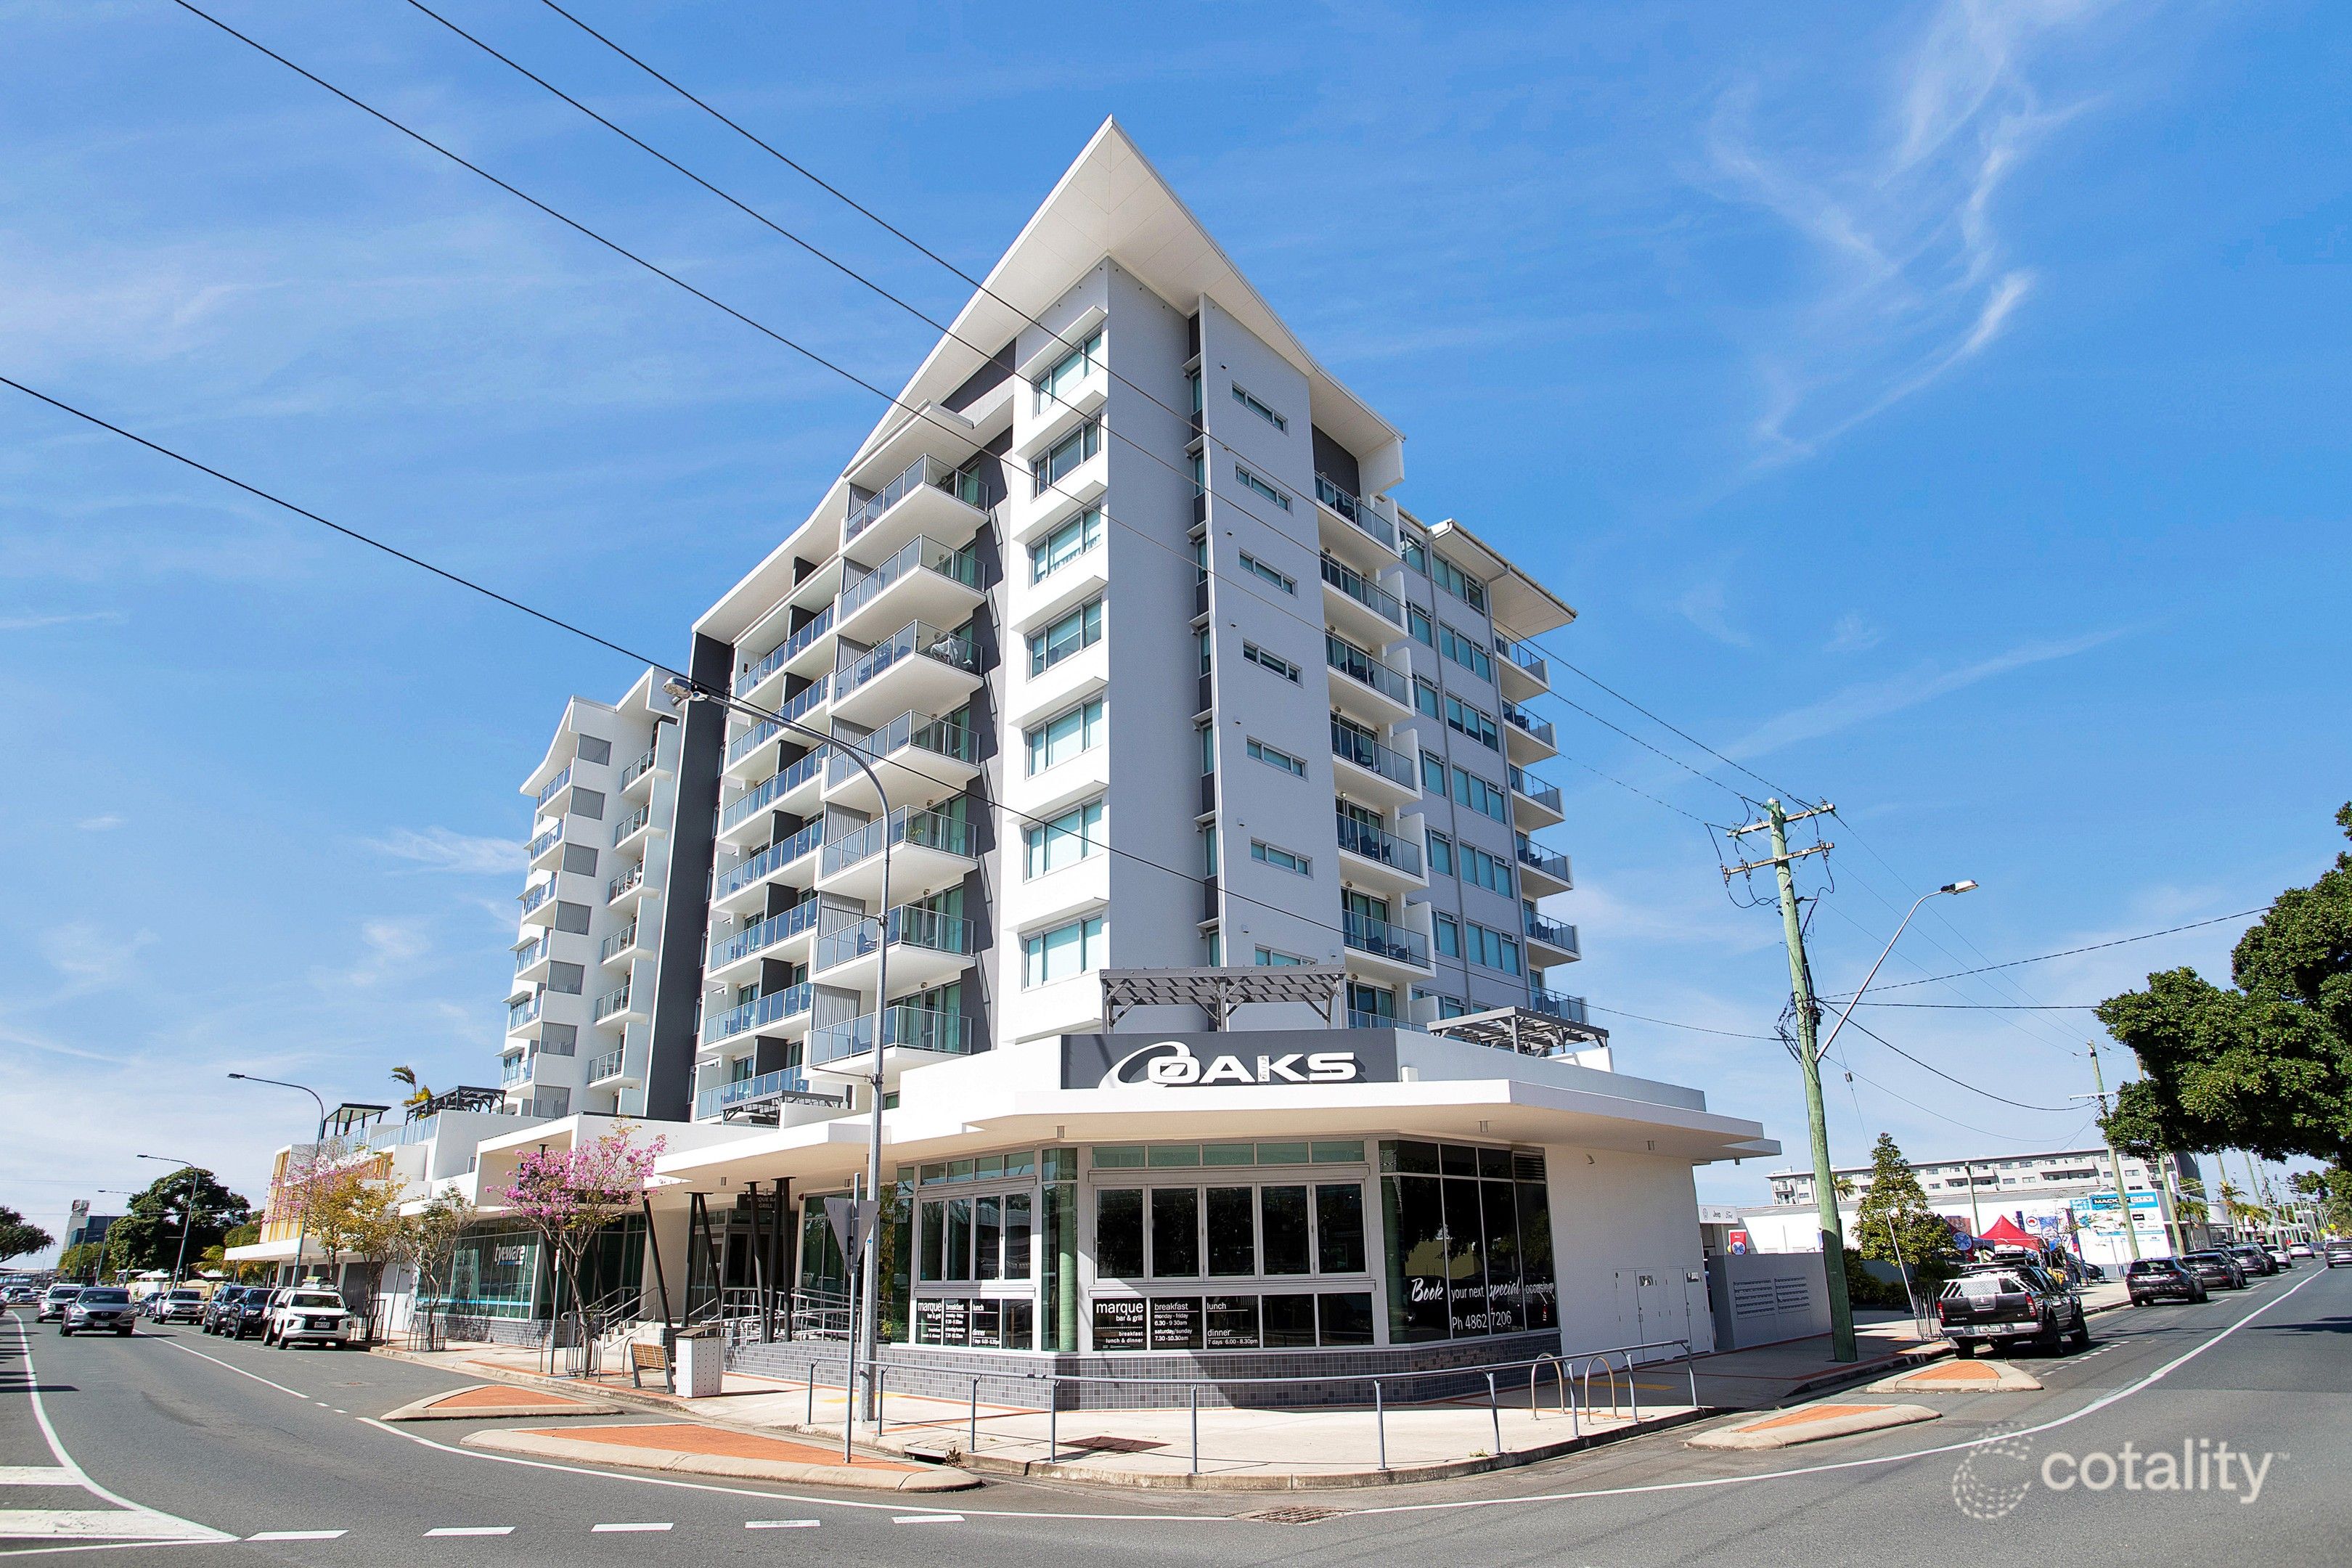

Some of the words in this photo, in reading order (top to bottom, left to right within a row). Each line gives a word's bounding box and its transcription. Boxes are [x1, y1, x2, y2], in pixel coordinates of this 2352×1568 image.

[1146, 1052, 1357, 1085] OAKS
[1411, 1278, 1443, 1302] Book
[1451, 1288, 1467, 1302] your
[1469, 1285, 1485, 1299] next
[1489, 1276, 1520, 1302] special
[918, 1302, 942, 1314] marque
[1096, 1302, 1144, 1316] marque
[1154, 1302, 1189, 1311] breakfast
[1452, 1316, 1463, 1331] Ph
[1465, 1314, 1487, 1329] 4862
[1490, 1310, 1512, 1326] 7206
